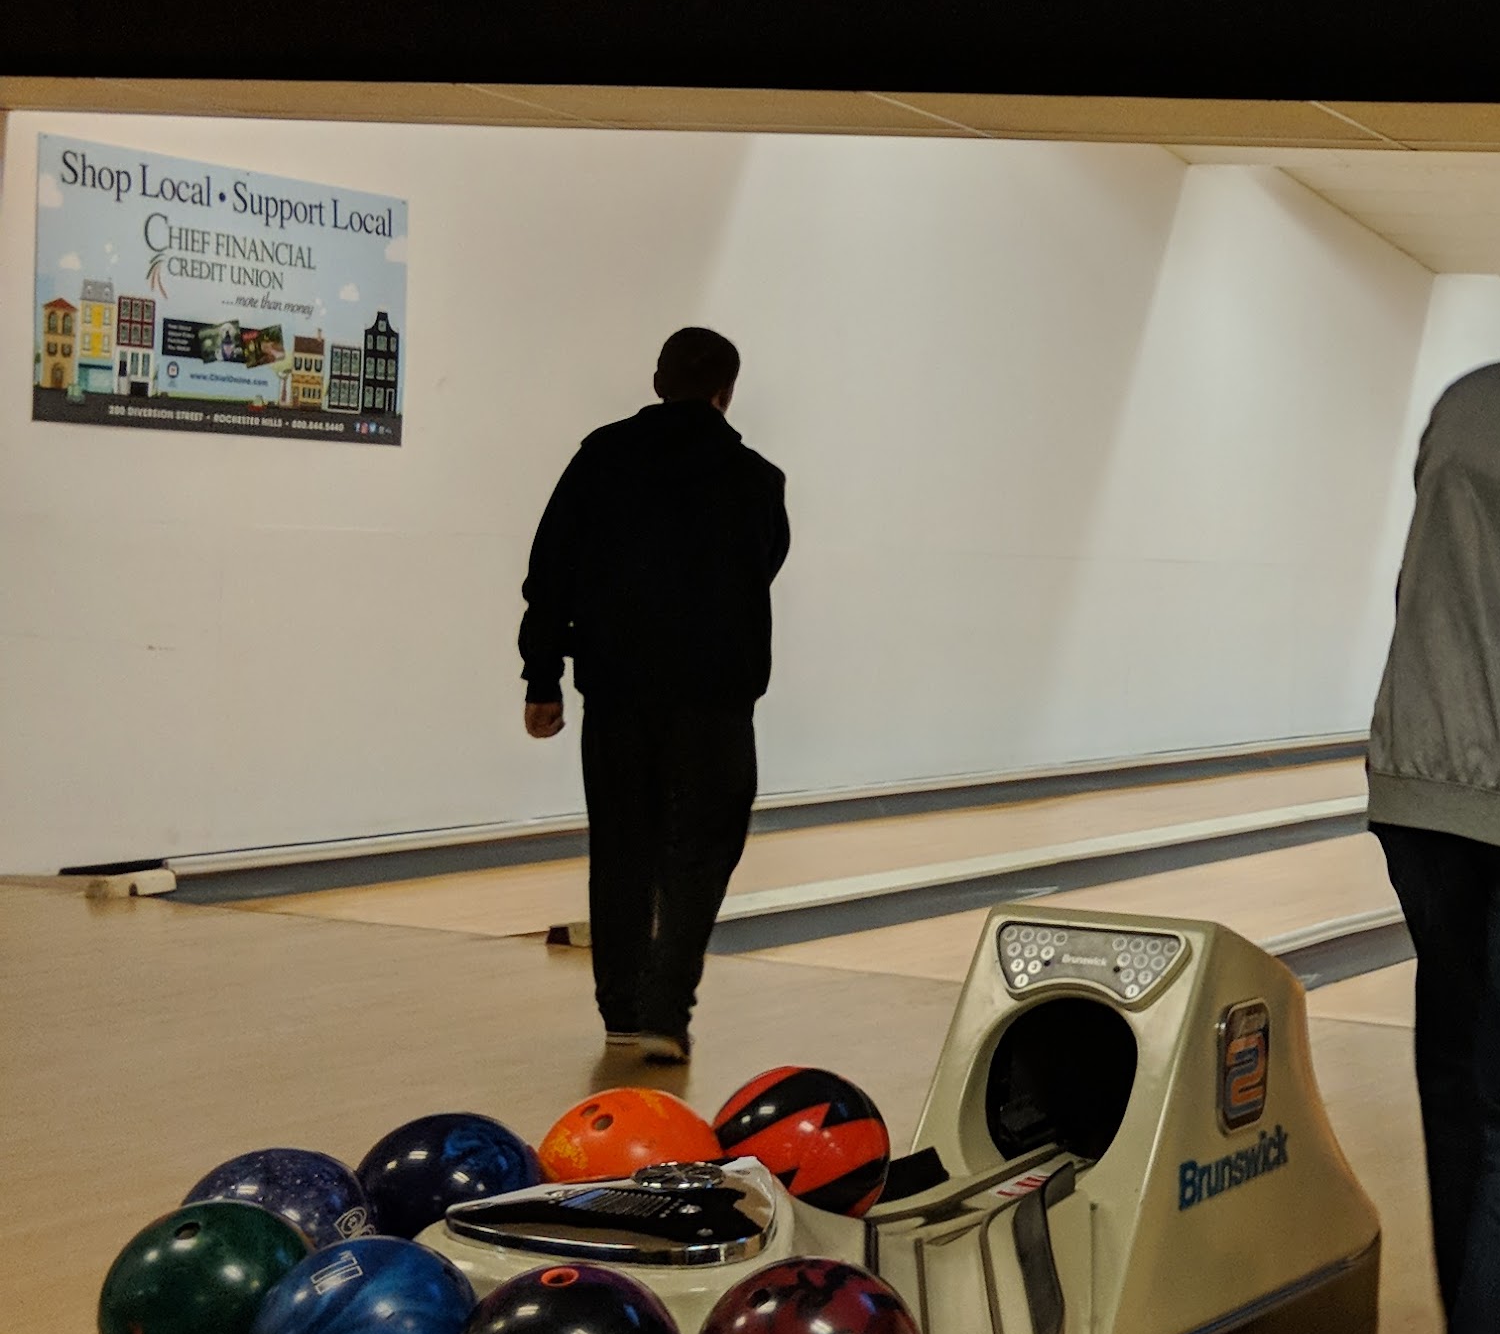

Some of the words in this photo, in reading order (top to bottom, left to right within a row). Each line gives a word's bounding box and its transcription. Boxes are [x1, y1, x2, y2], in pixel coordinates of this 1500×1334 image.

[61, 149, 132, 202] Shop
[139, 164, 212, 207] Local
[232, 181, 325, 230] Support
[332, 199, 393, 238] Local
[144, 212, 211, 255] CHIEF
[215, 232, 317, 270] FINANCIAL
[167, 255, 226, 283] CREDIT
[230, 268, 284, 291] UNION
[260, 291, 282, 310] than
[283, 298, 314, 318] money
[1178, 1124, 1289, 1211] Brunswick
